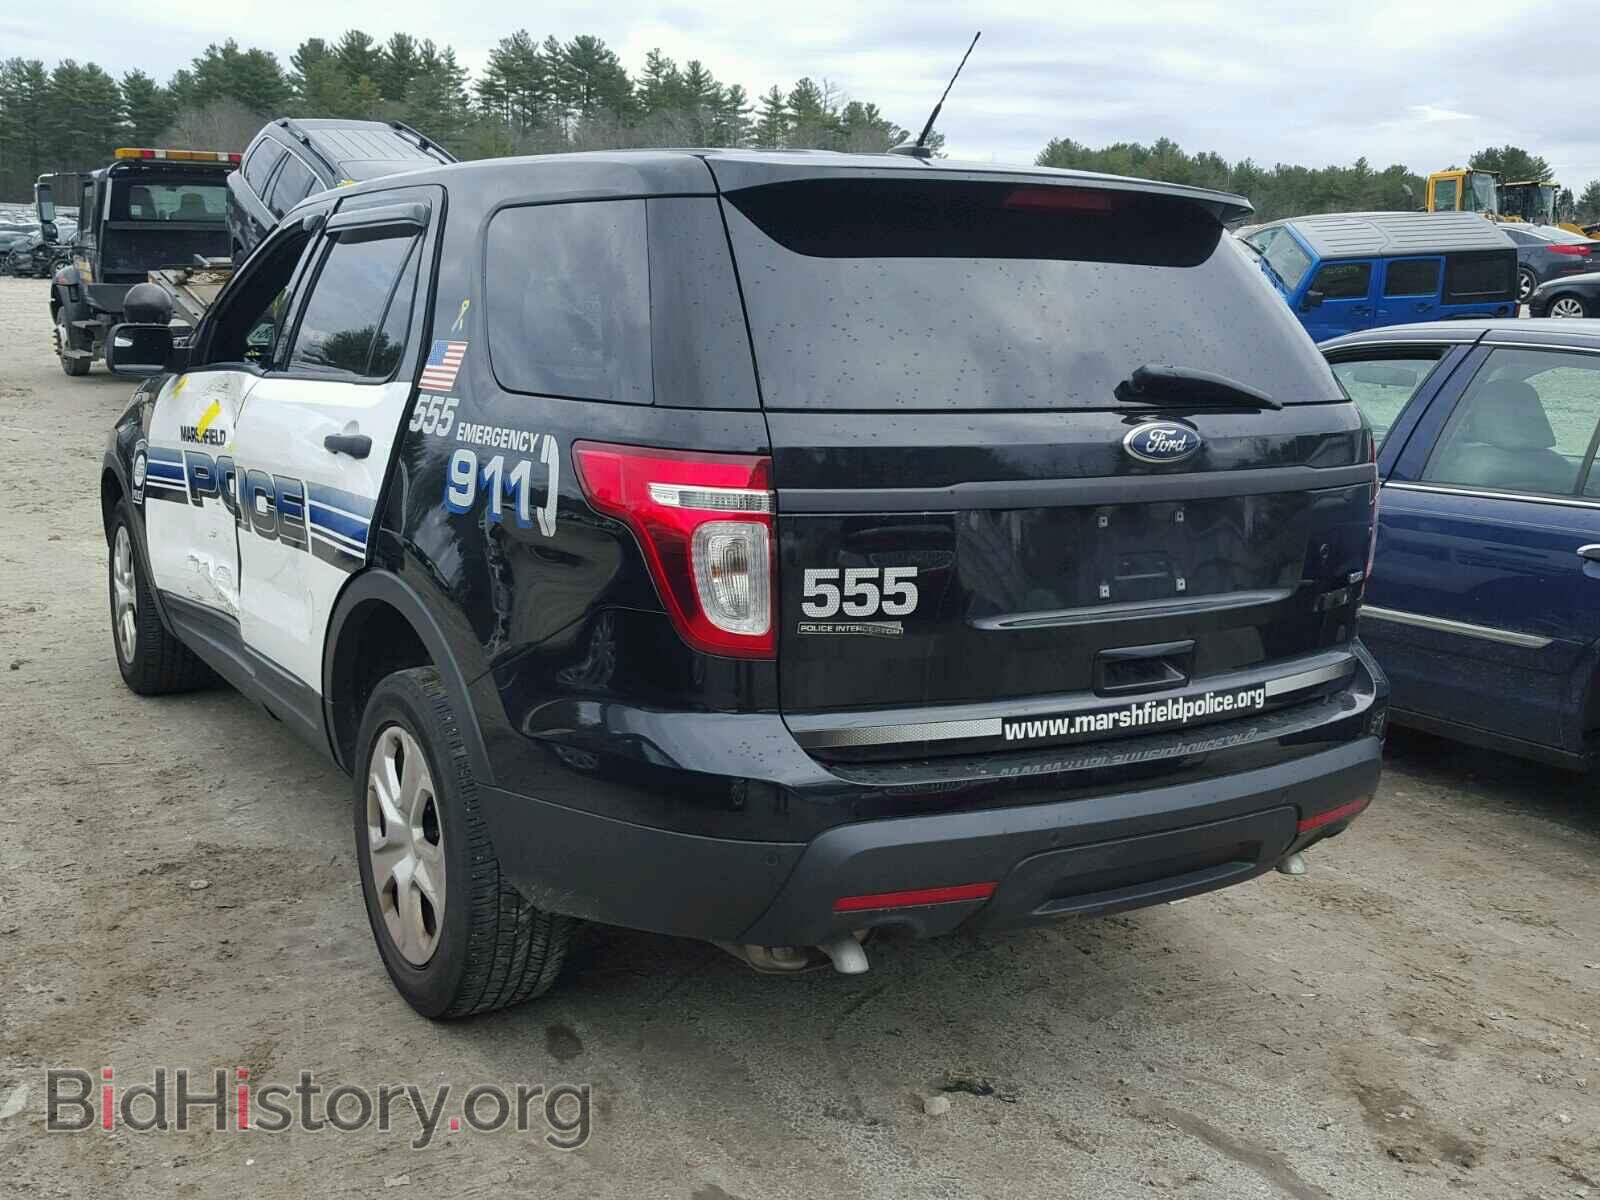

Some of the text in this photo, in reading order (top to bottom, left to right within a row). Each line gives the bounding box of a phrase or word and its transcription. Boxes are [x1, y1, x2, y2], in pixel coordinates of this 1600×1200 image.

[409, 394, 459, 437] 555
[456, 422, 539, 453] EMERGENCY
[1146, 429, 1187, 453] Ford
[184, 449, 309, 553] POICE
[444, 449, 533, 528] 911
[801, 566, 919, 618] 555
[800, 624, 833, 633] POLICE
[1003, 687, 1265, 741] www.marshfieldpolice.org
